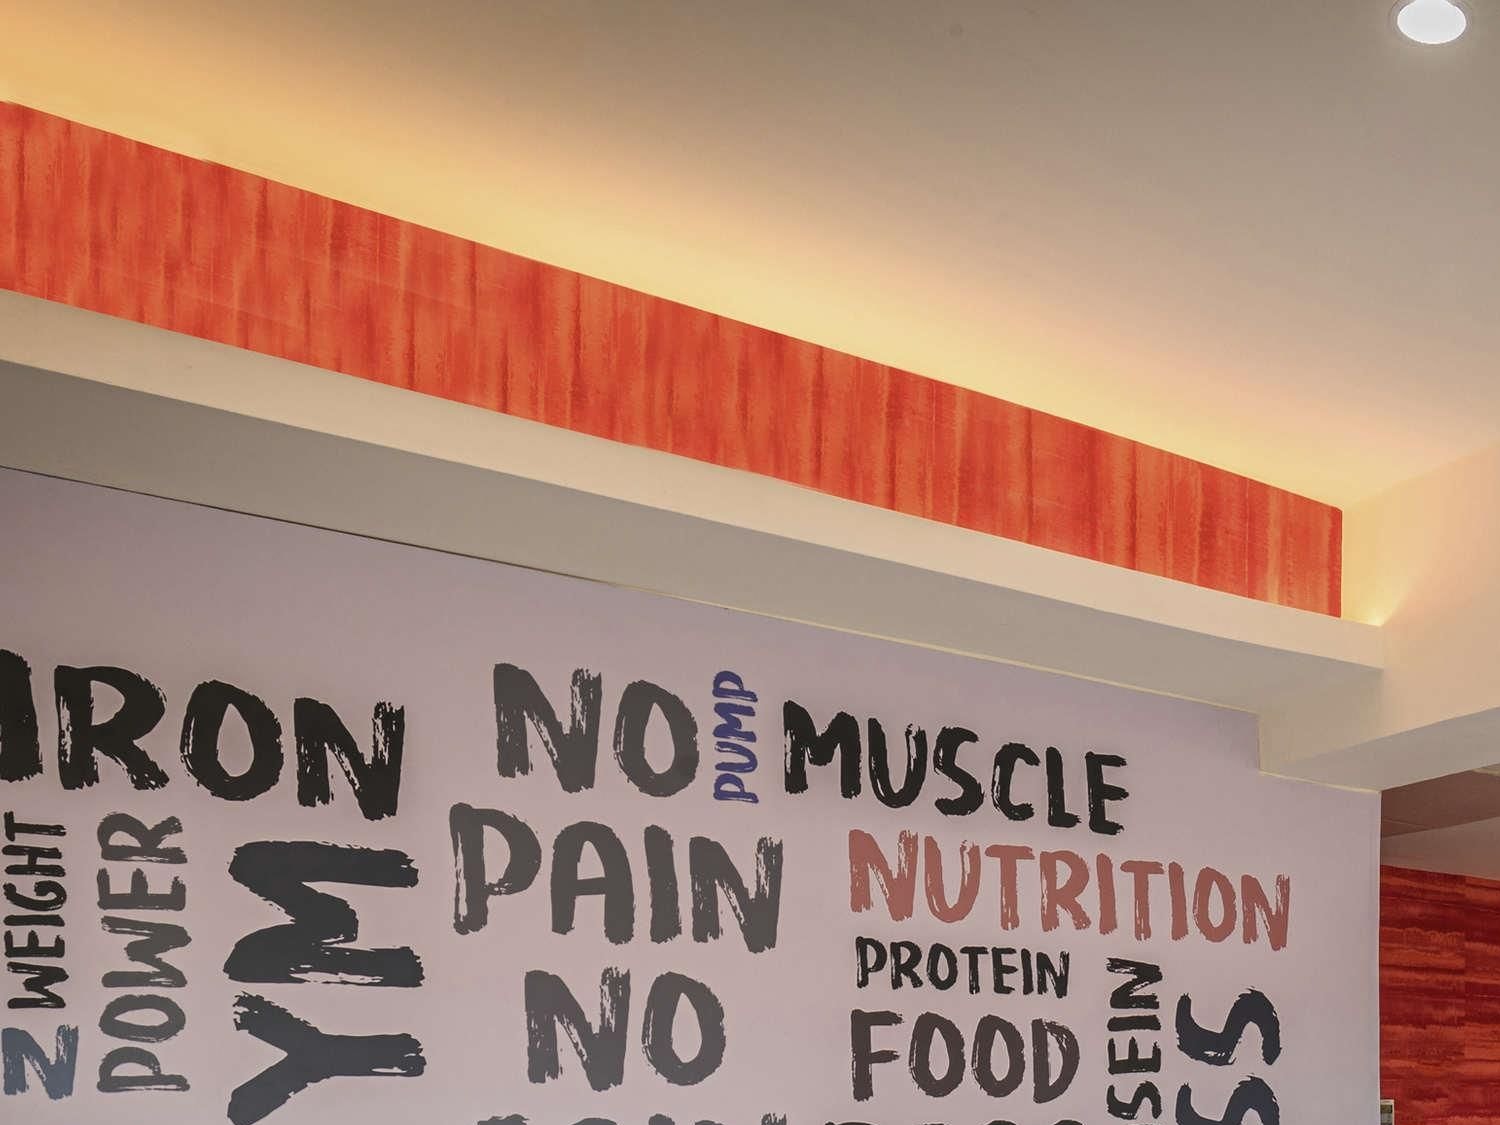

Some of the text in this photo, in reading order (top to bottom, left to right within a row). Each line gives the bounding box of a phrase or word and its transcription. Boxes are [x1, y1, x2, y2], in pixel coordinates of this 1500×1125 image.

[0, 649, 405, 821] IRON
[493, 663, 699, 797] NO
[712, 670, 758, 803] PUMP
[783, 700, 1129, 835] MUSCLE
[2, 812, 68, 1009] WEIGHT
[449, 803, 783, 953] PAIN
[848, 829, 1291, 951] NUTRITION
[97, 813, 191, 1093] POWER
[855, 936, 1070, 999] PROTEIN
[524, 966, 726, 1092] NO
[850, 1009, 1080, 1103] FOOD
